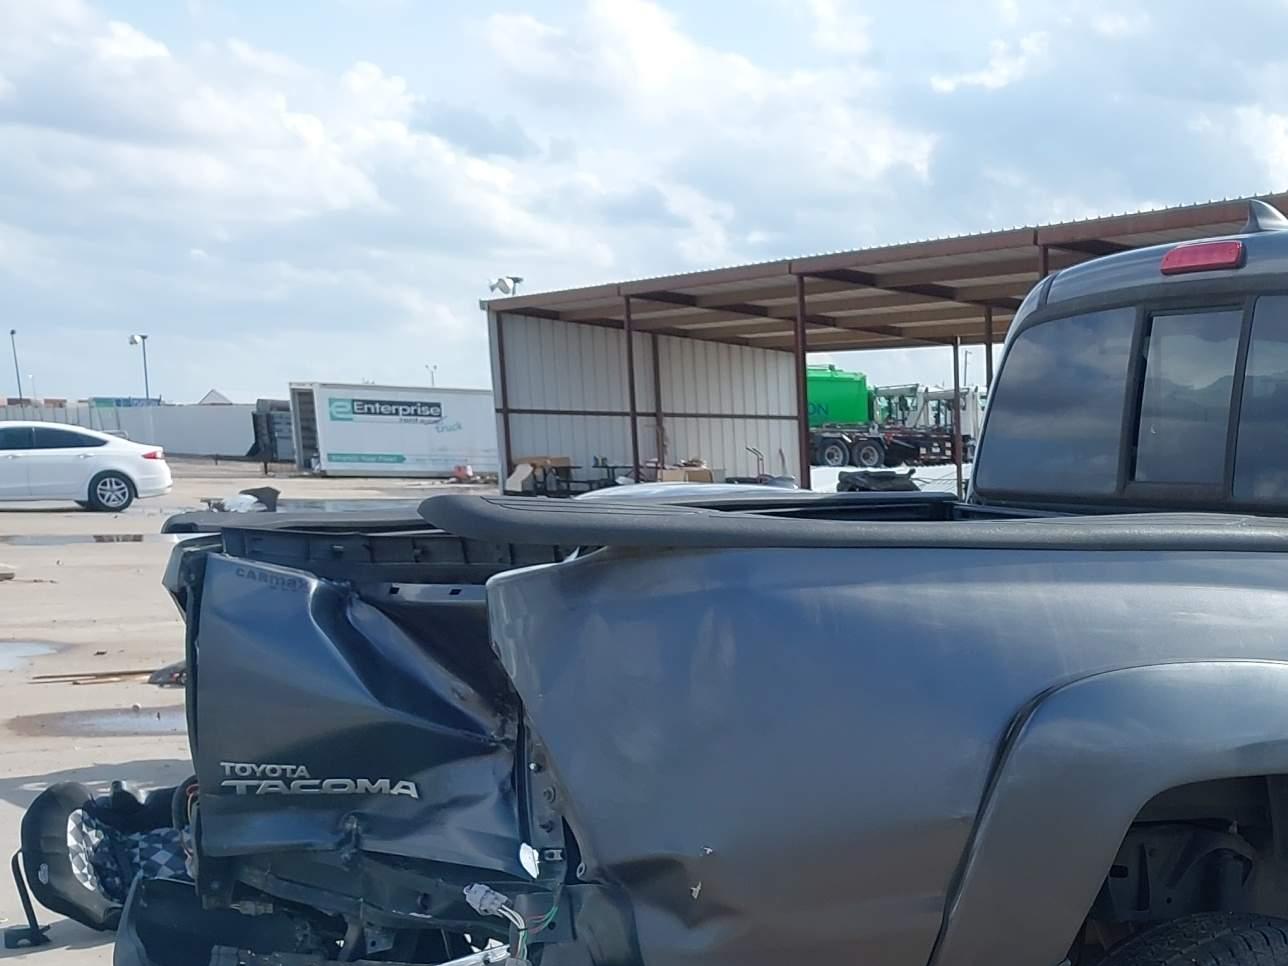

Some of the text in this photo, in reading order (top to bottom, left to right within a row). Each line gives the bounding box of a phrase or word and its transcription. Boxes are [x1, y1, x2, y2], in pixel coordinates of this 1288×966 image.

[353, 401, 441, 417] Enterprise
[220, 762, 310, 778] TOYOTA
[220, 779, 419, 799] TACOMA
